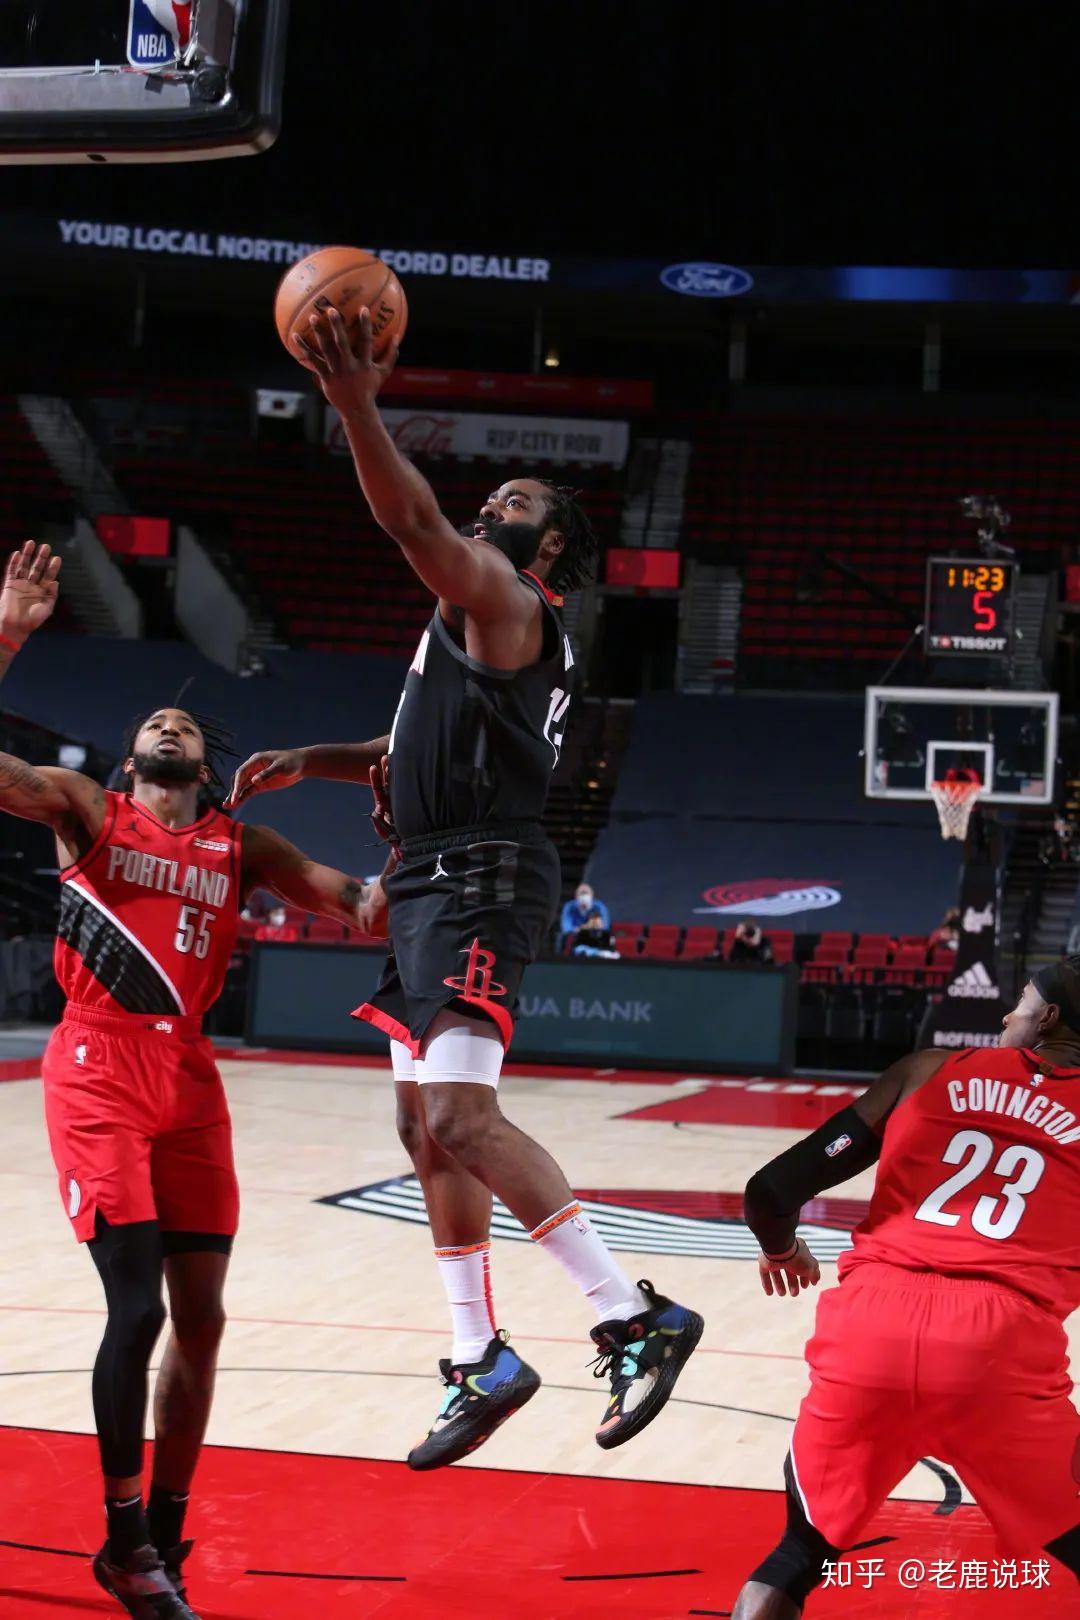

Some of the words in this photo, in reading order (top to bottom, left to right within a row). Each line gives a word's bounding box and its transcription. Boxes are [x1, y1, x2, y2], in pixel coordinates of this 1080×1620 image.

[136, 34, 168, 58] NBA
[58, 219, 130, 248] YOUR
[133, 228, 214, 256] LOCAL
[379, 250, 447, 275] FORD
[452, 254, 550, 281] DEALER
[486, 429, 518, 450] RIP
[520, 430, 559, 452] CITY
[563, 433, 603, 454] ROW
[948, 566, 1005, 591] 11:23
[973, 591, 996, 630] 5
[105, 845, 230, 909] PORTLAND
[174, 903, 217, 960] 55
[568, 997, 652, 1022] BANK
[947, 984, 1000, 999] adidas
[947, 1077, 1080, 1145] COVINGTON
[914, 1129, 1046, 1241] 23
